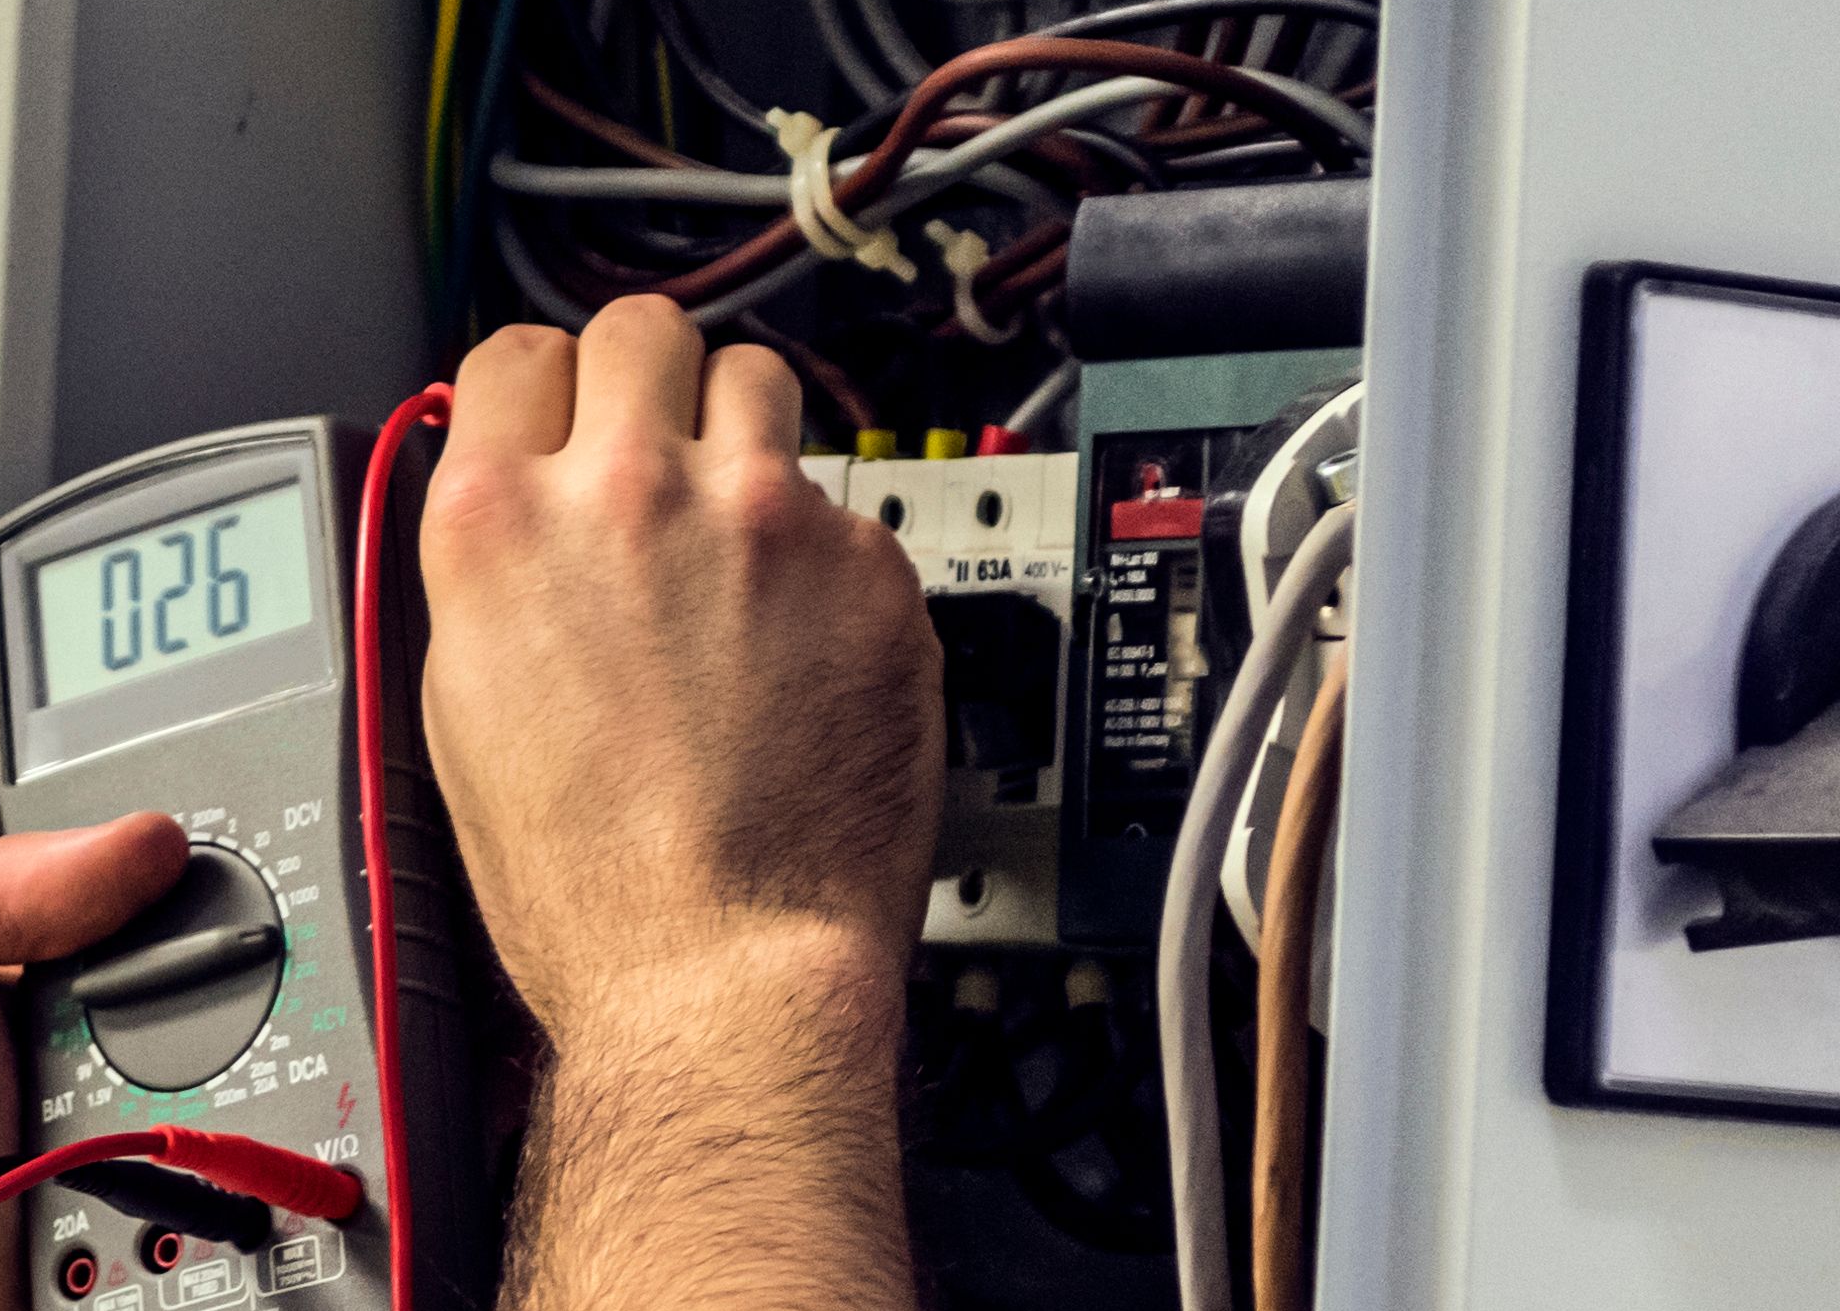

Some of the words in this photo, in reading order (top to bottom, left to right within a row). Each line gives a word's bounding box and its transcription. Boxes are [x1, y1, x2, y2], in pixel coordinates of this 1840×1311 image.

[977, 558, 1012, 582] 63A
[100, 515, 250, 673] 026
[228, 817, 237, 834] 2
[284, 799, 322, 831] DCV
[277, 855, 301, 875] 200
[288, 885, 320, 907] 1000
[289, 1053, 328, 1084] DCA
[42, 1091, 75, 1123] BAT
[53, 1209, 91, 1241] 20A
